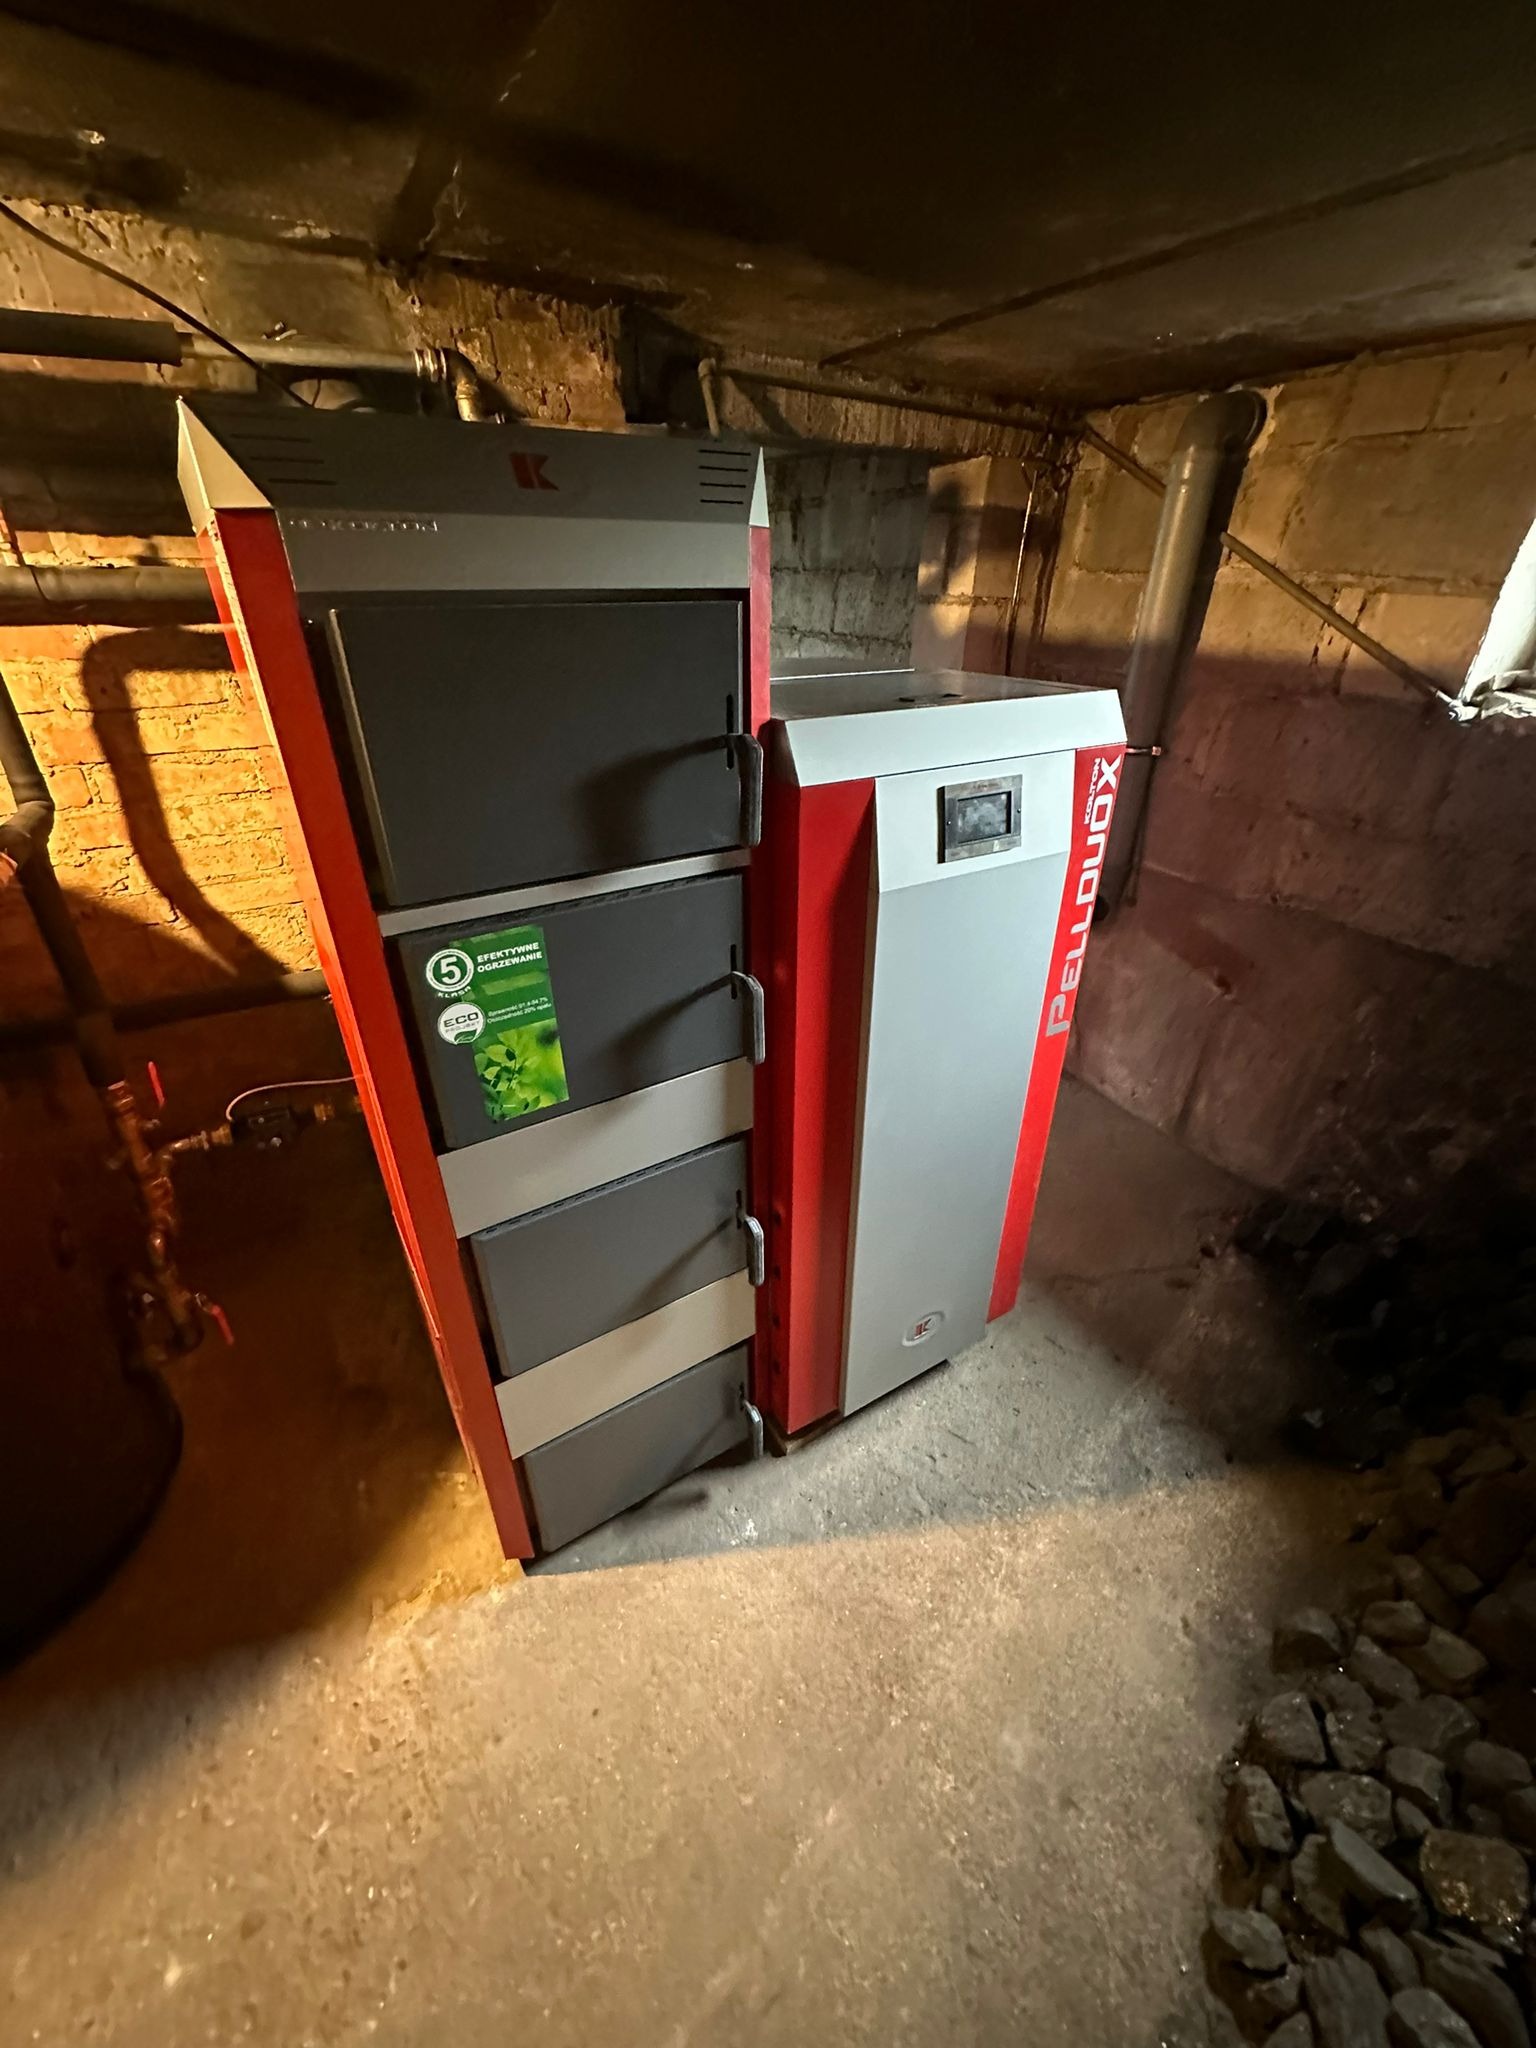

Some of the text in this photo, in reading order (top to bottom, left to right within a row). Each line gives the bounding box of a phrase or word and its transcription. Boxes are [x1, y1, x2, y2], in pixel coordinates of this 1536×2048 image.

[1084, 757, 1103, 825] KOLTON
[477, 942, 539, 963] EFEKTYWNE
[477, 951, 543, 973] OGRZEWANIE
[440, 956, 461, 985] 5
[437, 986, 471, 999] KLASA
[444, 1012, 479, 1027] ECO
